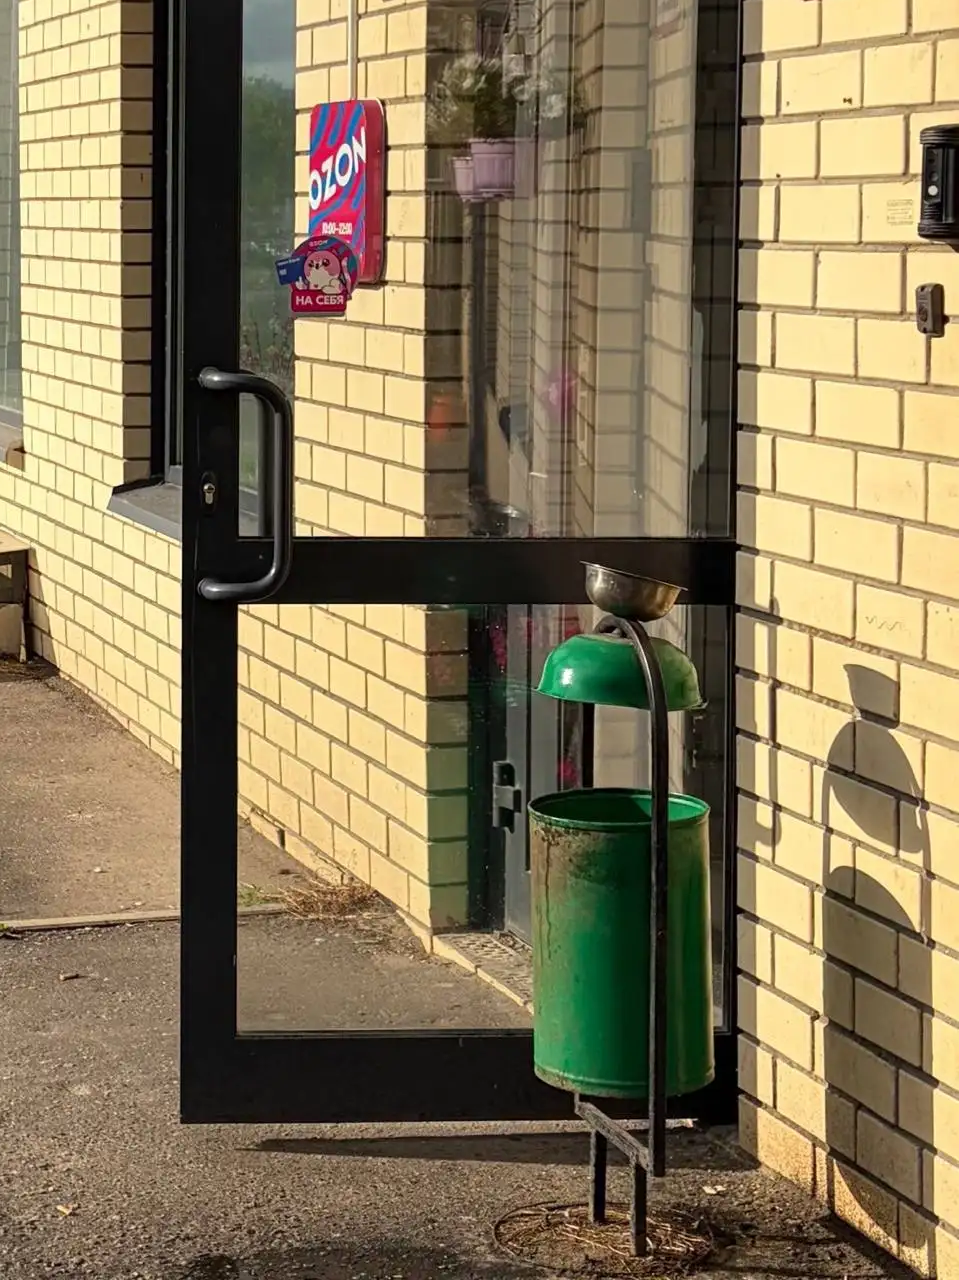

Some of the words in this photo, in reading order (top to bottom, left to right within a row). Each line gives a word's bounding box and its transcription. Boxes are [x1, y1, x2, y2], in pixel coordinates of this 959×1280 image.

[309, 126, 367, 210] OZON
[295, 295, 313, 306] НА
[315, 295, 344, 306] СЕБЯ
